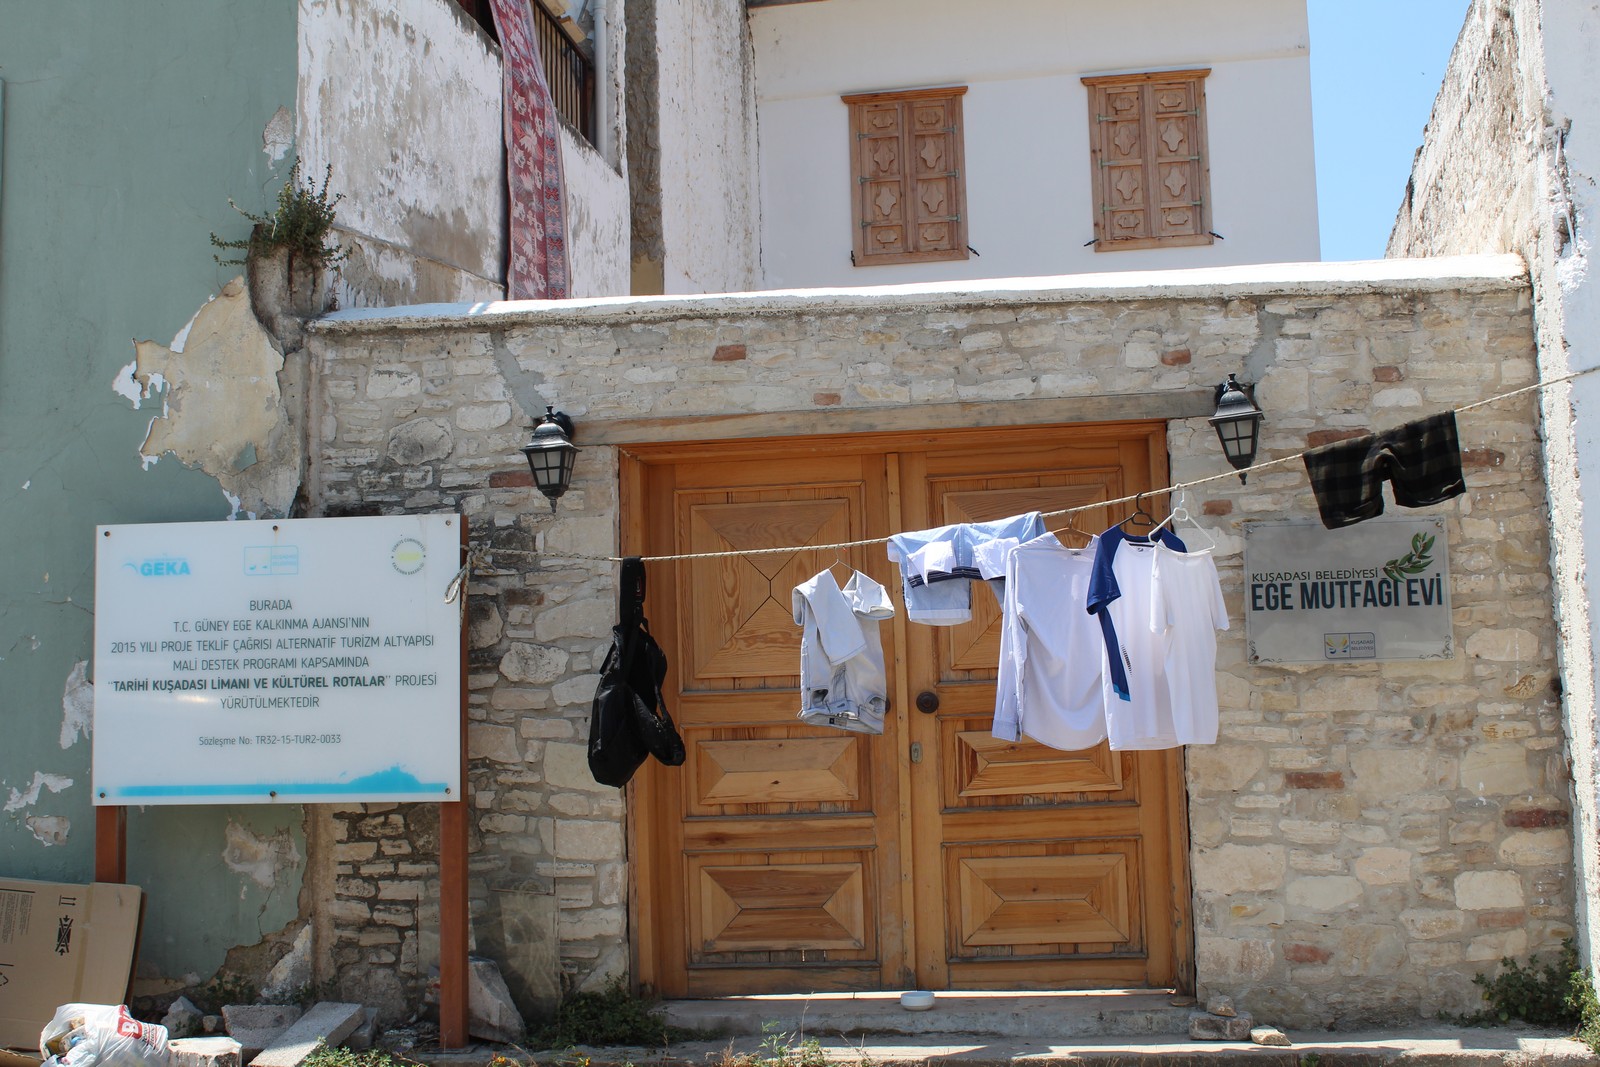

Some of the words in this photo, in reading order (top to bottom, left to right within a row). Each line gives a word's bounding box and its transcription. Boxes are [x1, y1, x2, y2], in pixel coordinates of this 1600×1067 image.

[140, 561, 191, 577] GEKA
[1252, 571, 1311, 583] KUŞADASI
[1315, 567, 1379, 580] BELEDİYESİ
[1251, 581, 1294, 611] EGE
[1300, 577, 1400, 610] MUTFAĞI
[1406, 573, 1443, 607] EVİ
[249, 599, 293, 612] BURADA
[173, 621, 191, 632] T.C.
[194, 618, 229, 632] GÜNEY
[232, 619, 252, 631] EGE
[255, 618, 309, 630] KALKINMA
[312, 617, 370, 629] AJANSI'NIN
[111, 641, 137, 653] 2015
[140, 641, 157, 652] YILI
[161, 641, 192, 652] PROJE
[196, 637, 229, 651] TEKLİF
[232, 637, 272, 653] ÇAĞRISI
[275, 634, 336, 650] ALTERNATİF
[340, 634, 380, 648] TURİZM
[383, 635, 434, 647] ALTYAPISI
[173, 657, 198, 671] MALİ
[201, 659, 240, 671] DESTEK
[243, 658, 297, 670] PROGRAMI
[301, 656, 369, 669] KAPSAMINDA
[152, 679, 207, 693] KUŞADASI
[211, 676, 250, 690] LİMANI
[253, 678, 268, 689] VE
[272, 674, 329, 688] KÜLTÜREL
[395, 671, 437, 686] PROJESİ
[220, 694, 320, 709] YÜRÜTÜLMEKTEDİR
[198, 736, 236, 747] Sözleşme
[239, 736, 253, 745] No:
[255, 734, 342, 745] TR32-15-TUR2-0033
